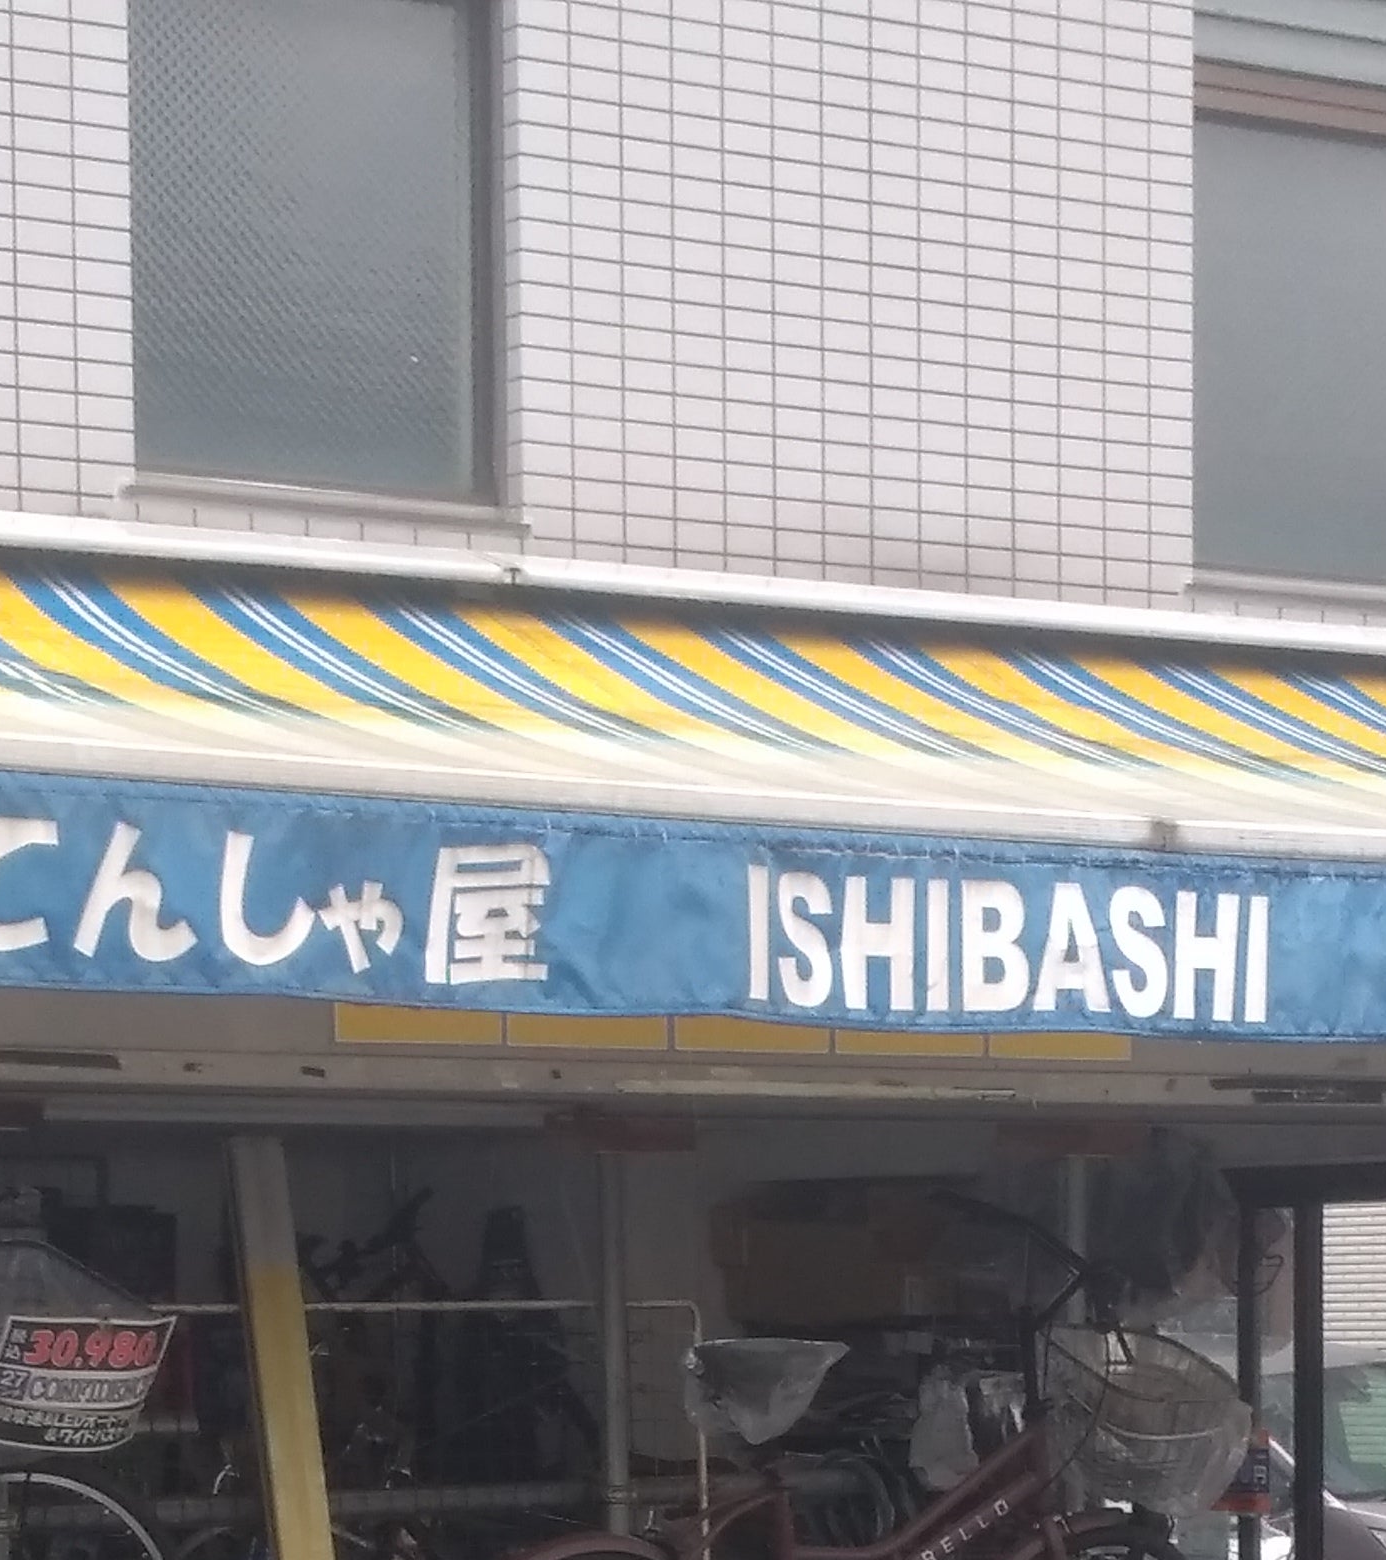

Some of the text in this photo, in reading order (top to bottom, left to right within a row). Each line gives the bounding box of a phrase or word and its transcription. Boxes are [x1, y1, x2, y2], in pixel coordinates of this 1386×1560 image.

[746, 862, 1270, 1024] ISHIBASHI
[23, 1328, 158, 1368] 30.980
[0, 1371, 28, 1388] 27
